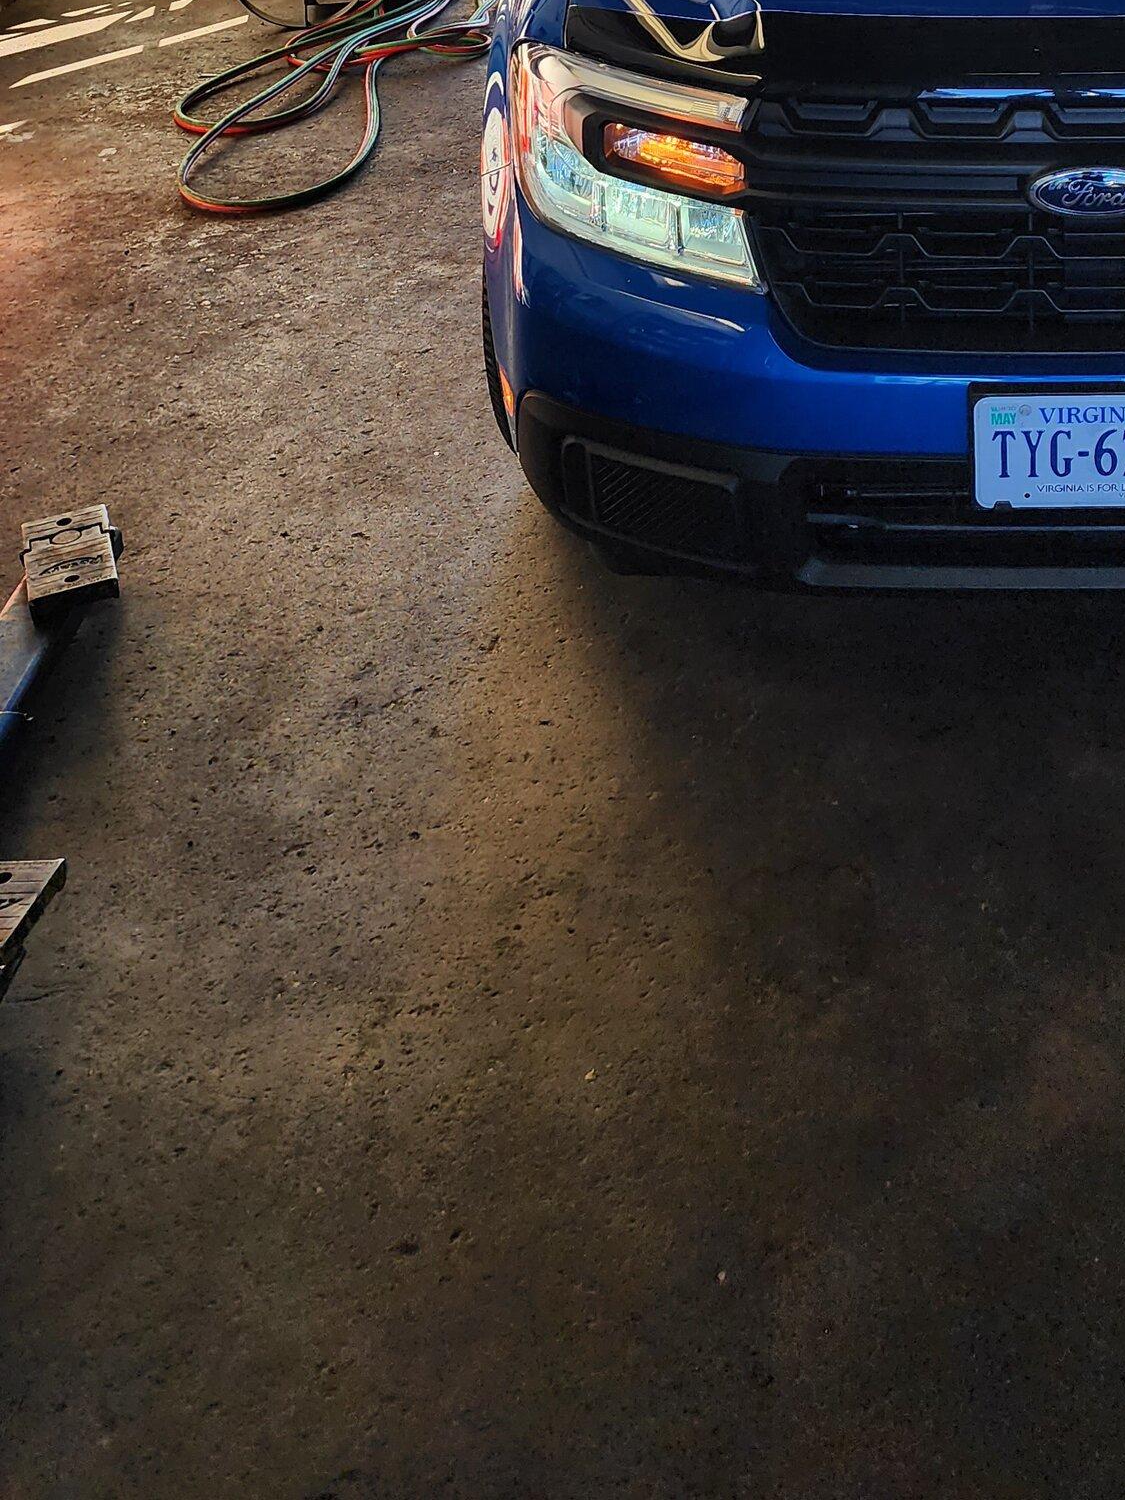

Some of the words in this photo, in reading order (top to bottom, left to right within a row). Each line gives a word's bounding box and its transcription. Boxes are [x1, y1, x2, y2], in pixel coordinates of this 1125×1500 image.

[991, 412, 1017, 425] MAY
[1037, 484, 1085, 493] VIRGINIA
[1087, 484, 1095, 492] IS
[1098, 484, 1119, 492] FOR
